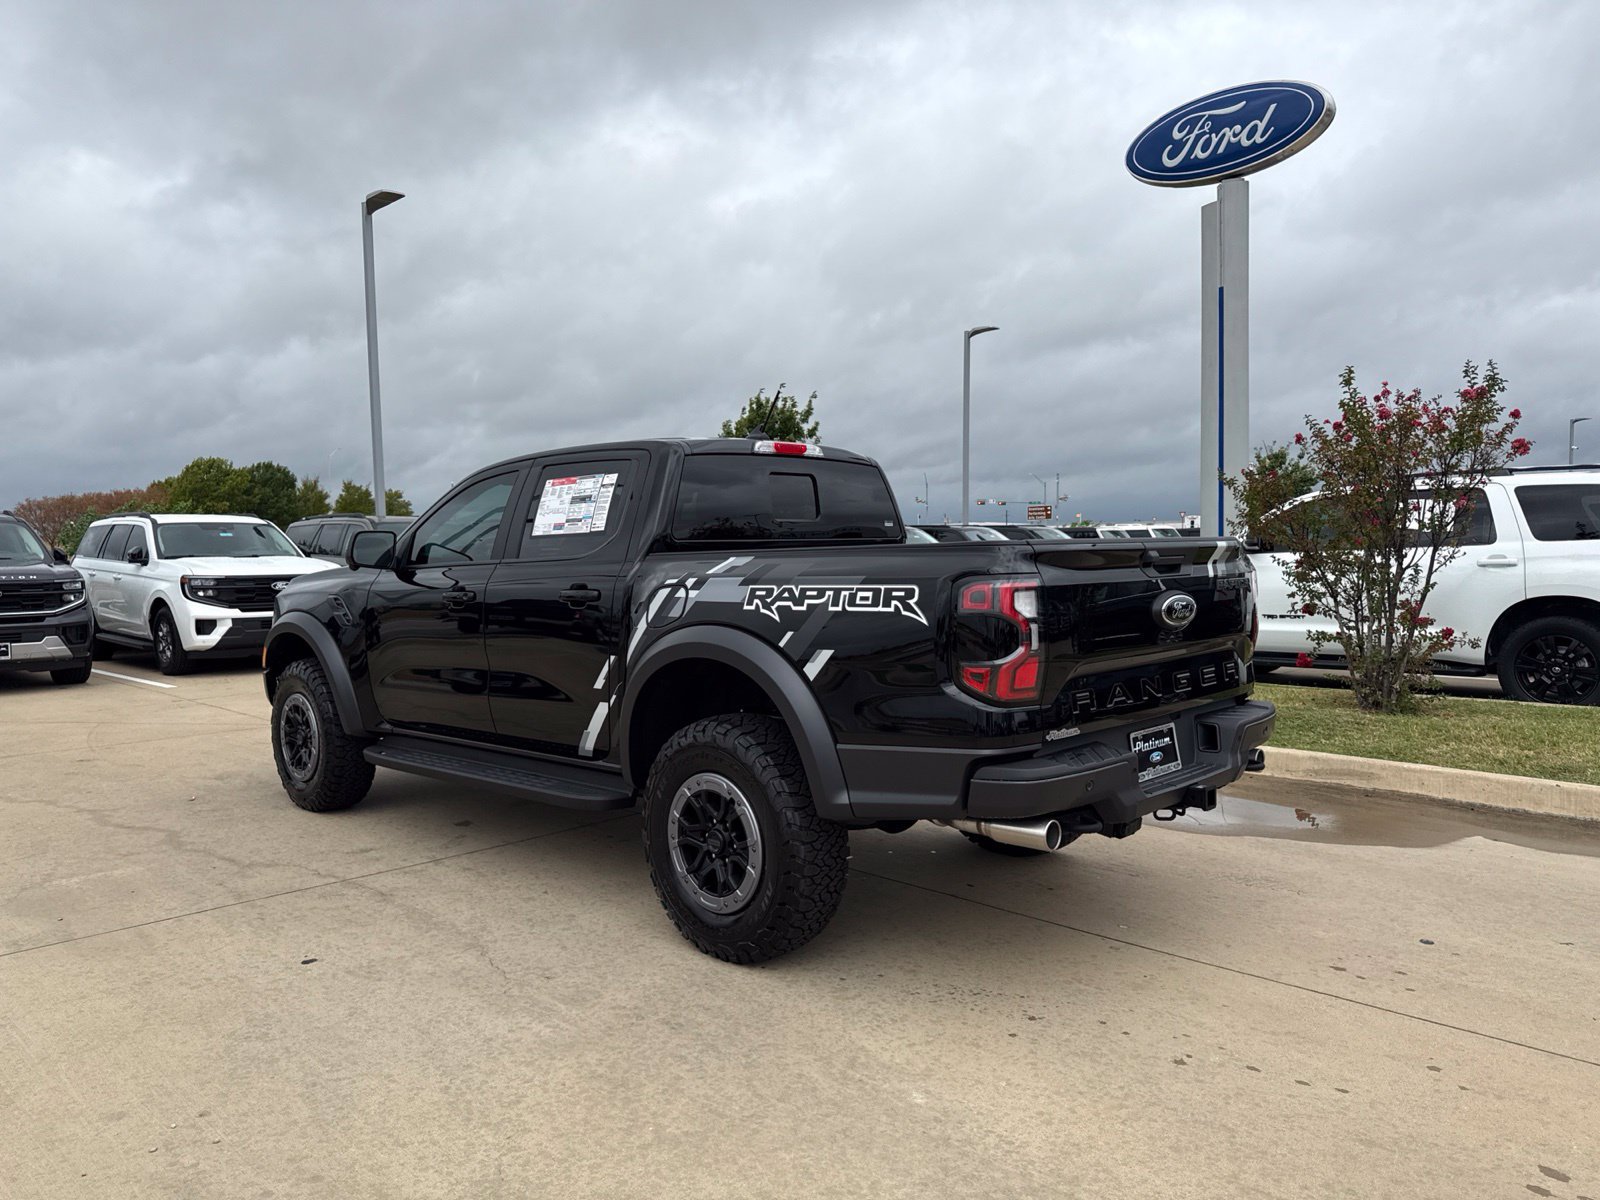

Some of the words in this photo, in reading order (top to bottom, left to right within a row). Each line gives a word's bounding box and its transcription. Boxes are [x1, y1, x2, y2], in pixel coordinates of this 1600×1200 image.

[1162, 101, 1277, 167] Ford
[743, 585, 929, 626] RAPTOR
[1172, 601, 1191, 618] Ford
[1071, 661, 1239, 714] RANGER
[1133, 737, 1172, 753] Platinum
